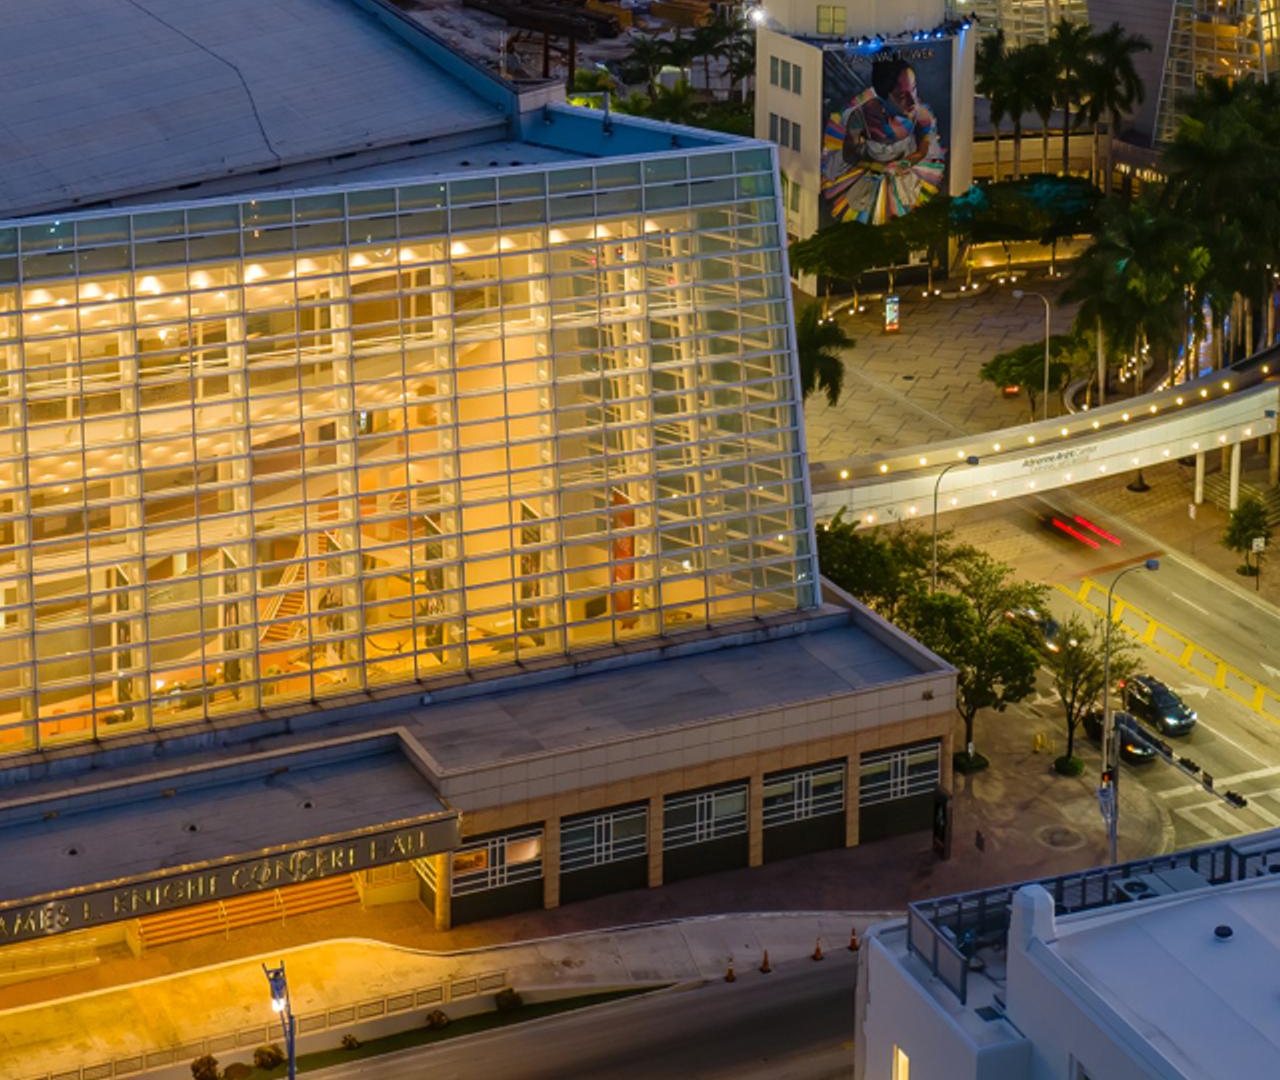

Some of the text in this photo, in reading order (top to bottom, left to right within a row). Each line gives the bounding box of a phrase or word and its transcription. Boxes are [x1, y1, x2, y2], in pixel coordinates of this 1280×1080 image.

[113, 874, 218, 914] KNIGHT
[231, 846, 357, 890] CONCERT
[370, 829, 430, 862] HALL
